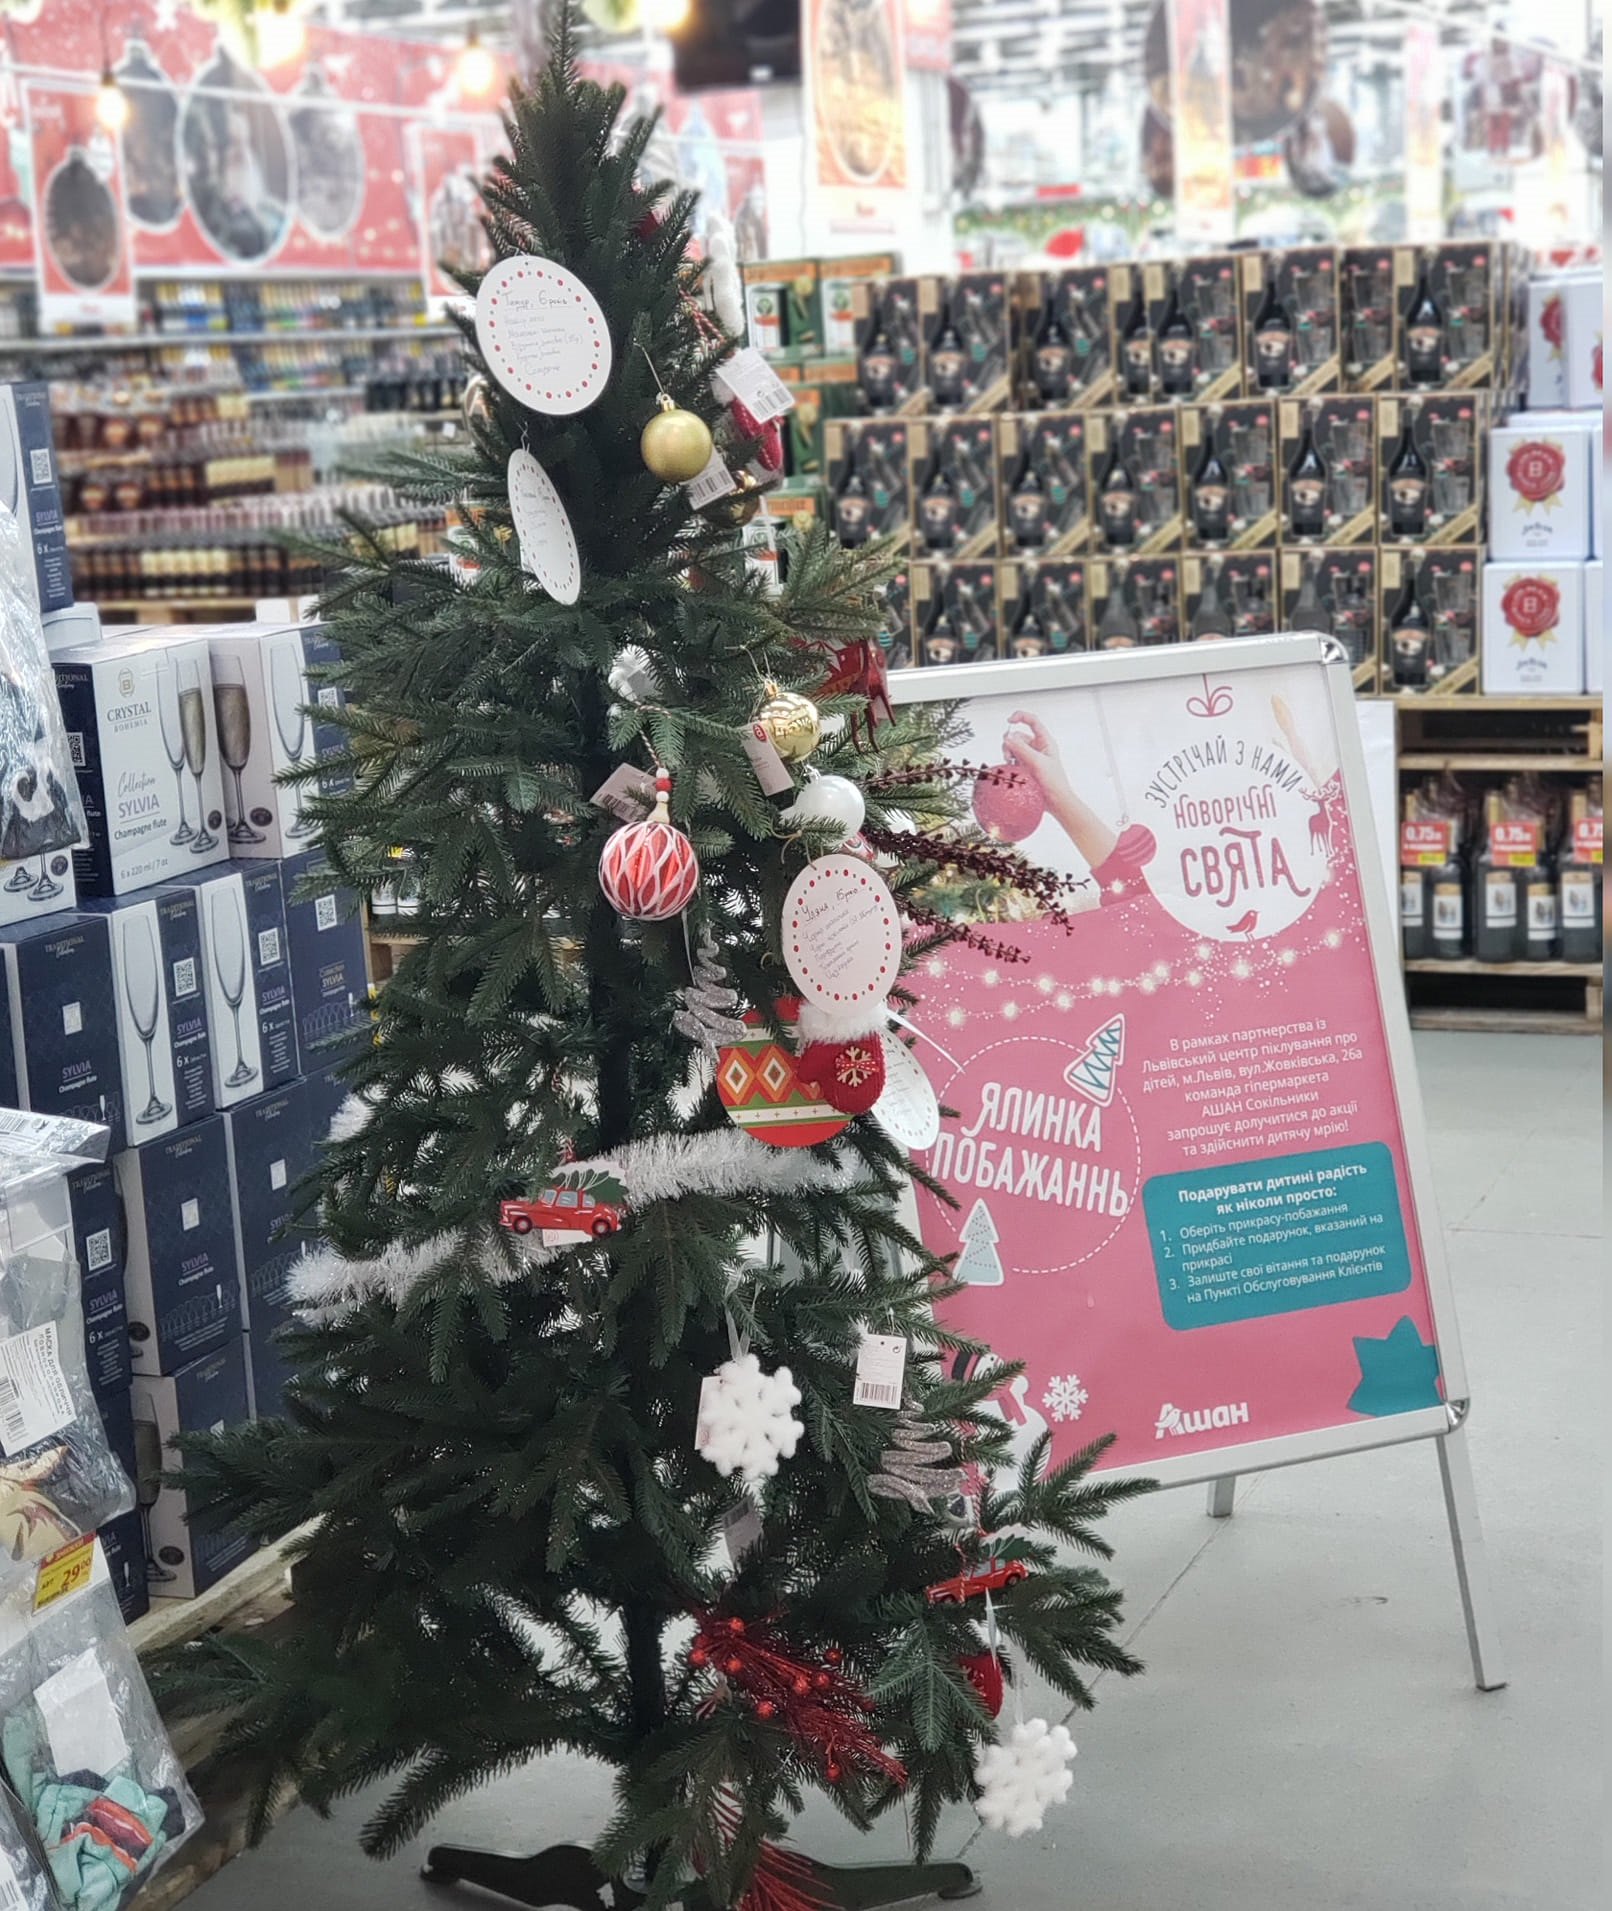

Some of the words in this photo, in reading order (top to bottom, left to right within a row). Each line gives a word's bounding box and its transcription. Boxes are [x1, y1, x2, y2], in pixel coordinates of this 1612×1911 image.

[107, 701, 152, 723] CRYSTAL
[114, 719, 149, 733] BOHEMIA
[117, 771, 156, 798] Collection
[1145, 734, 1227, 809] ЗУСТРІЧАЙ
[1235, 740, 1245, 766] З
[1251, 745, 1303, 792] НАМИ
[118, 794, 160, 819] SYLVIA
[1173, 784, 1277, 829] НОВОРІЧНІ
[114, 822, 152, 841] Champagne
[152, 818, 168, 829] flute
[1180, 826, 1311, 907] СВЯТА
[262, 986, 286, 1001] SYLVIA
[177, 1018, 202, 1035] SYLVIA
[1169, 1039, 1179, 1052] В
[1182, 1032, 1230, 1052] рамках
[1232, 1021, 1314, 1043] партнерства
[1315, 1018, 1327, 1031] із
[62, 1060, 92, 1079] SYLVIA
[1142, 1049, 1217, 1074] Львівський
[1219, 1046, 1259, 1064] центр
[1261, 1035, 1332, 1055] піклування
[1335, 1033, 1358, 1048] про
[1142, 1074, 1180, 1093] дітей,
[1182, 1067, 1237, 1085] м.Львів,
[1239, 1052, 1340, 1077] вул.Жовківська,
[1342, 1048, 1363, 1061] 26а
[1185, 1083, 1242, 1103] команда
[1244, 1072, 1329, 1093] гіпермаркета
[1202, 1100, 1243, 1118] АШАН
[1246, 1090, 1319, 1111] Сокільники
[960, 1081, 1101, 1152] ЯЛИНКА
[1167, 1123, 1232, 1142] запрошує
[1234, 1110, 1308, 1132] долучитися
[1311, 1108, 1326, 1120] до
[1329, 1101, 1359, 1116] акції
[1183, 1145, 1198, 1157] та
[1200, 1133, 1265, 1154] здійснити
[1268, 1126, 1311, 1146] дитячу
[1313, 1119, 1349, 1138] мрію!
[931, 1132, 1128, 1217] ПОБАЖАННЬ
[1178, 1180, 1263, 1203] Подарувати
[1265, 1171, 1314, 1191] дитині
[1317, 1164, 1367, 1184] радість
[1217, 1204, 1233, 1215] як
[1236, 1196, 1283, 1213] ніколи
[1286, 1186, 1337, 1206] просто:
[1160, 1229, 1172, 1242] 1.
[1179, 1222, 1226, 1240] Оберіть
[1229, 1203, 1348, 1230] прикрасу-побажання
[1164, 1247, 1175, 1258] 2.
[1182, 1234, 1246, 1255] Придбайте
[1248, 1227, 1312, 1246] подарунок,
[1314, 1215, 1367, 1233] вказаний
[1369, 1214, 1383, 1225] на
[181, 1252, 209, 1272] SYLVIA
[1169, 1279, 1180, 1290] 3.
[1188, 1269, 1239, 1288] Залиште
[1240, 1266, 1264, 1279] свої
[1266, 1258, 1309, 1275] вітання
[1311, 1256, 1324, 1266] та
[1326, 1245, 1386, 1263] подарунок
[1182, 1252, 1233, 1273] прикрасі
[89, 1289, 118, 1310] SYLVIA
[1187, 1293, 1202, 1304] на
[1204, 1285, 1242, 1302] Пункті
[1243, 1269, 1336, 1294] Обслуговування
[1338, 1261, 1383, 1277] Клієнтів
[1154, 1402, 1249, 1440] Ашан
